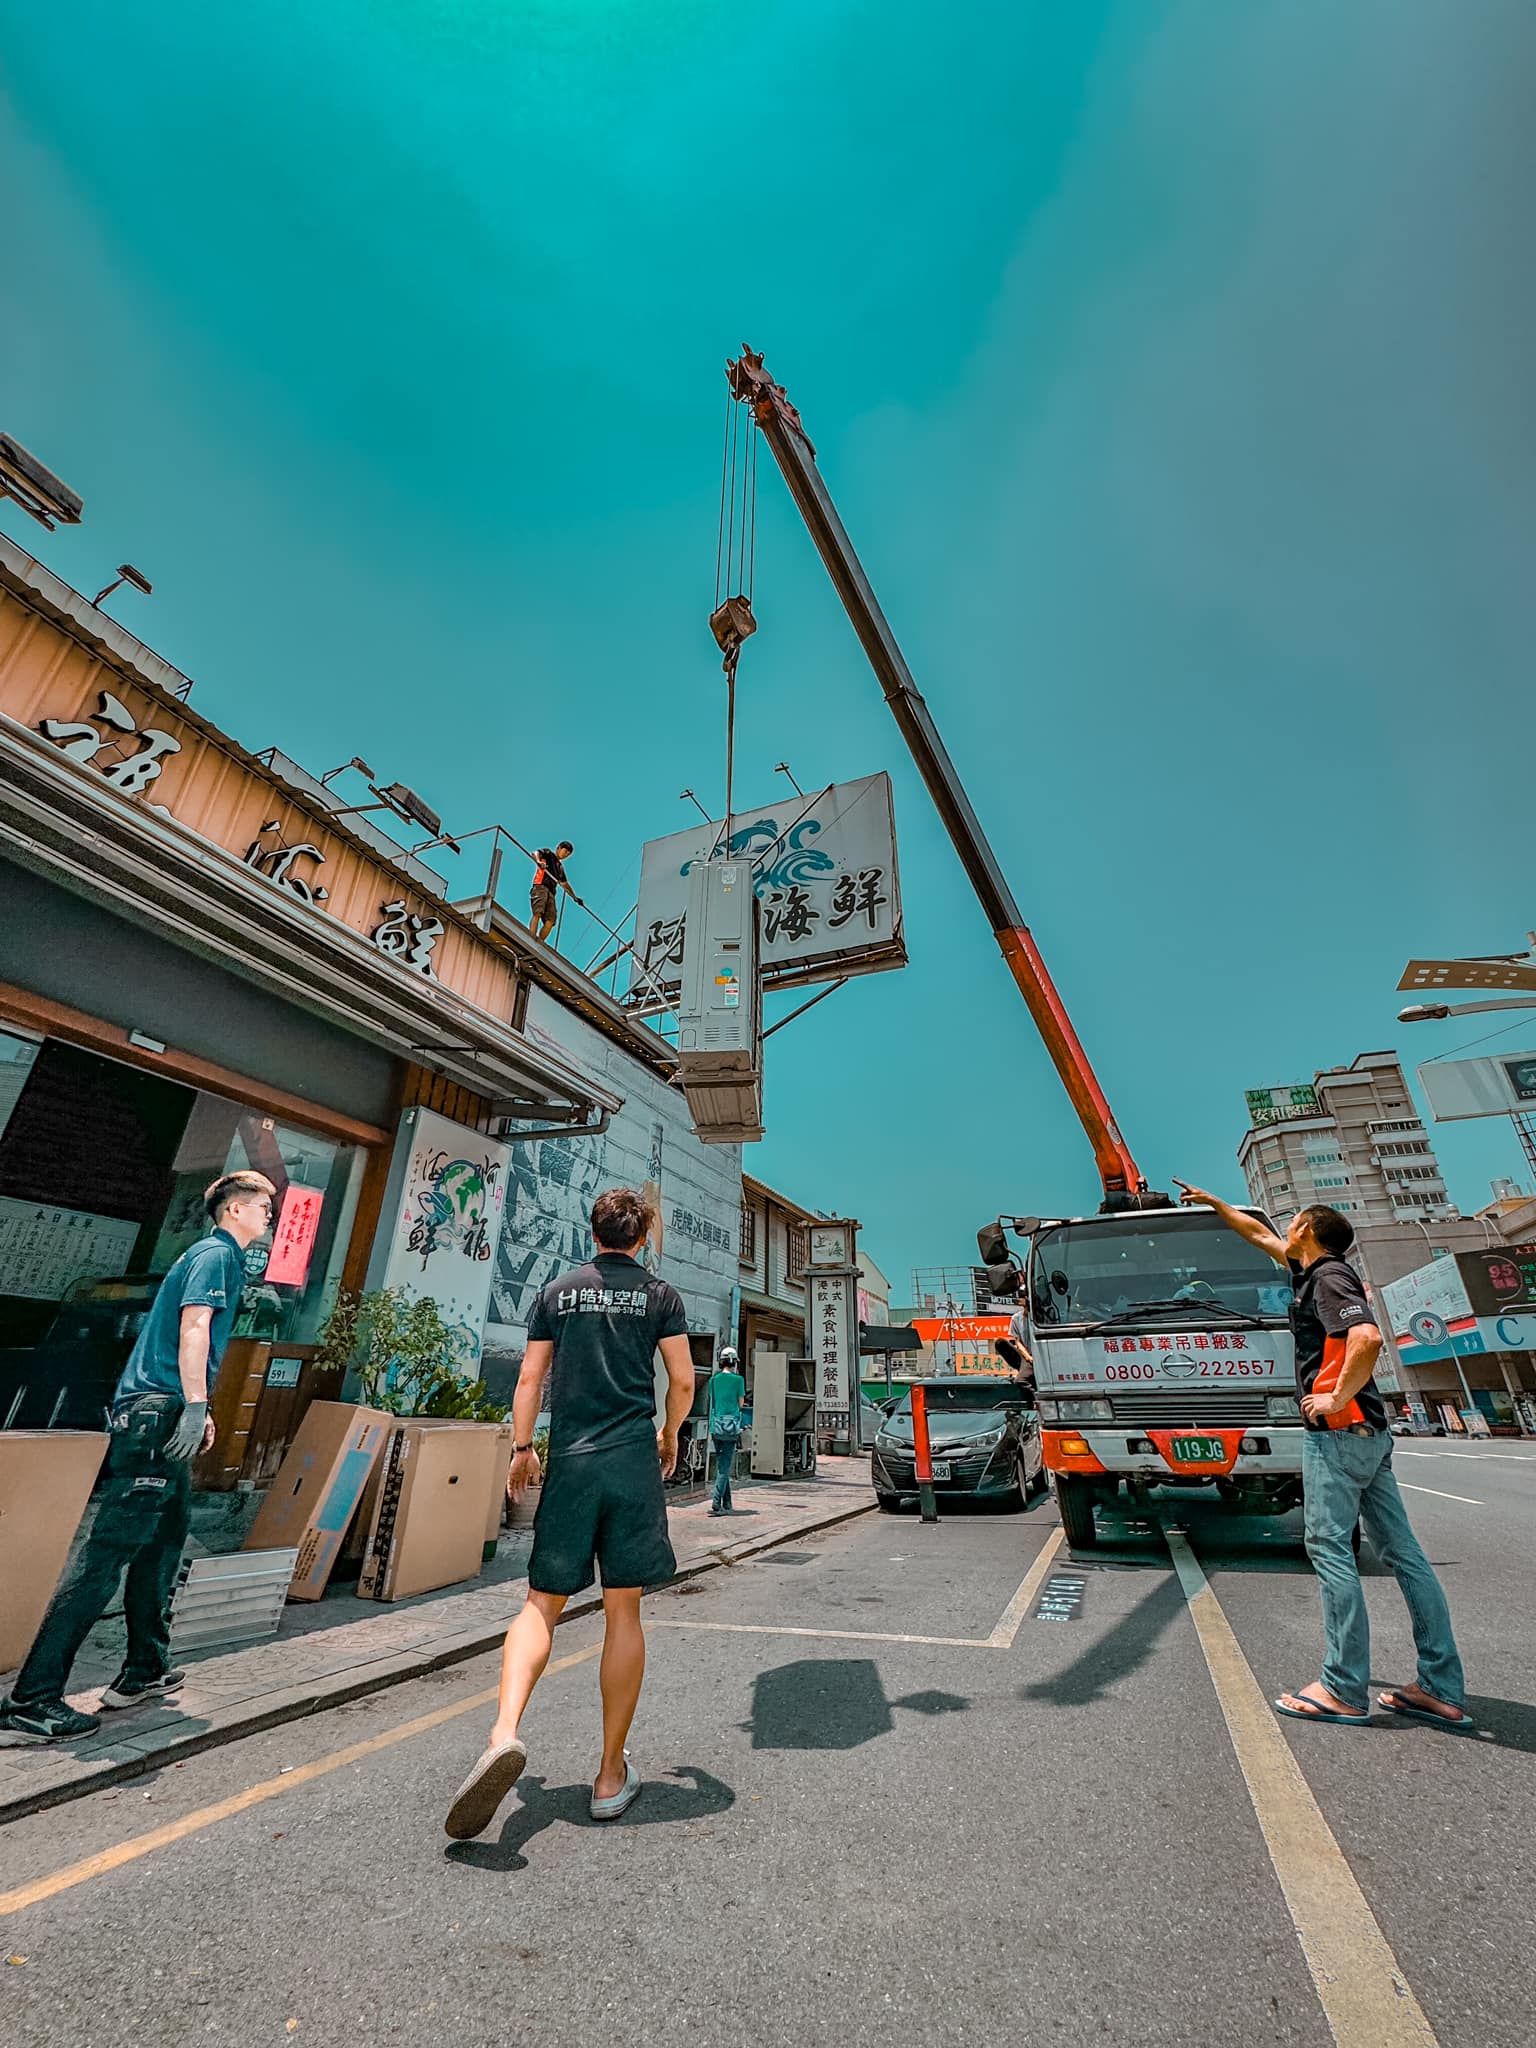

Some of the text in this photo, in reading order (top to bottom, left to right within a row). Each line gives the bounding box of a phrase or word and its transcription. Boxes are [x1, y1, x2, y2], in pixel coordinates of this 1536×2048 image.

[822, 1303, 839, 1398] 素食料理餐廳
[1103, 1334, 1249, 1353] 福鑫專業吊車搬家
[271, 1370, 286, 1379] 591
[1199, 1359, 1275, 1376] 222557
